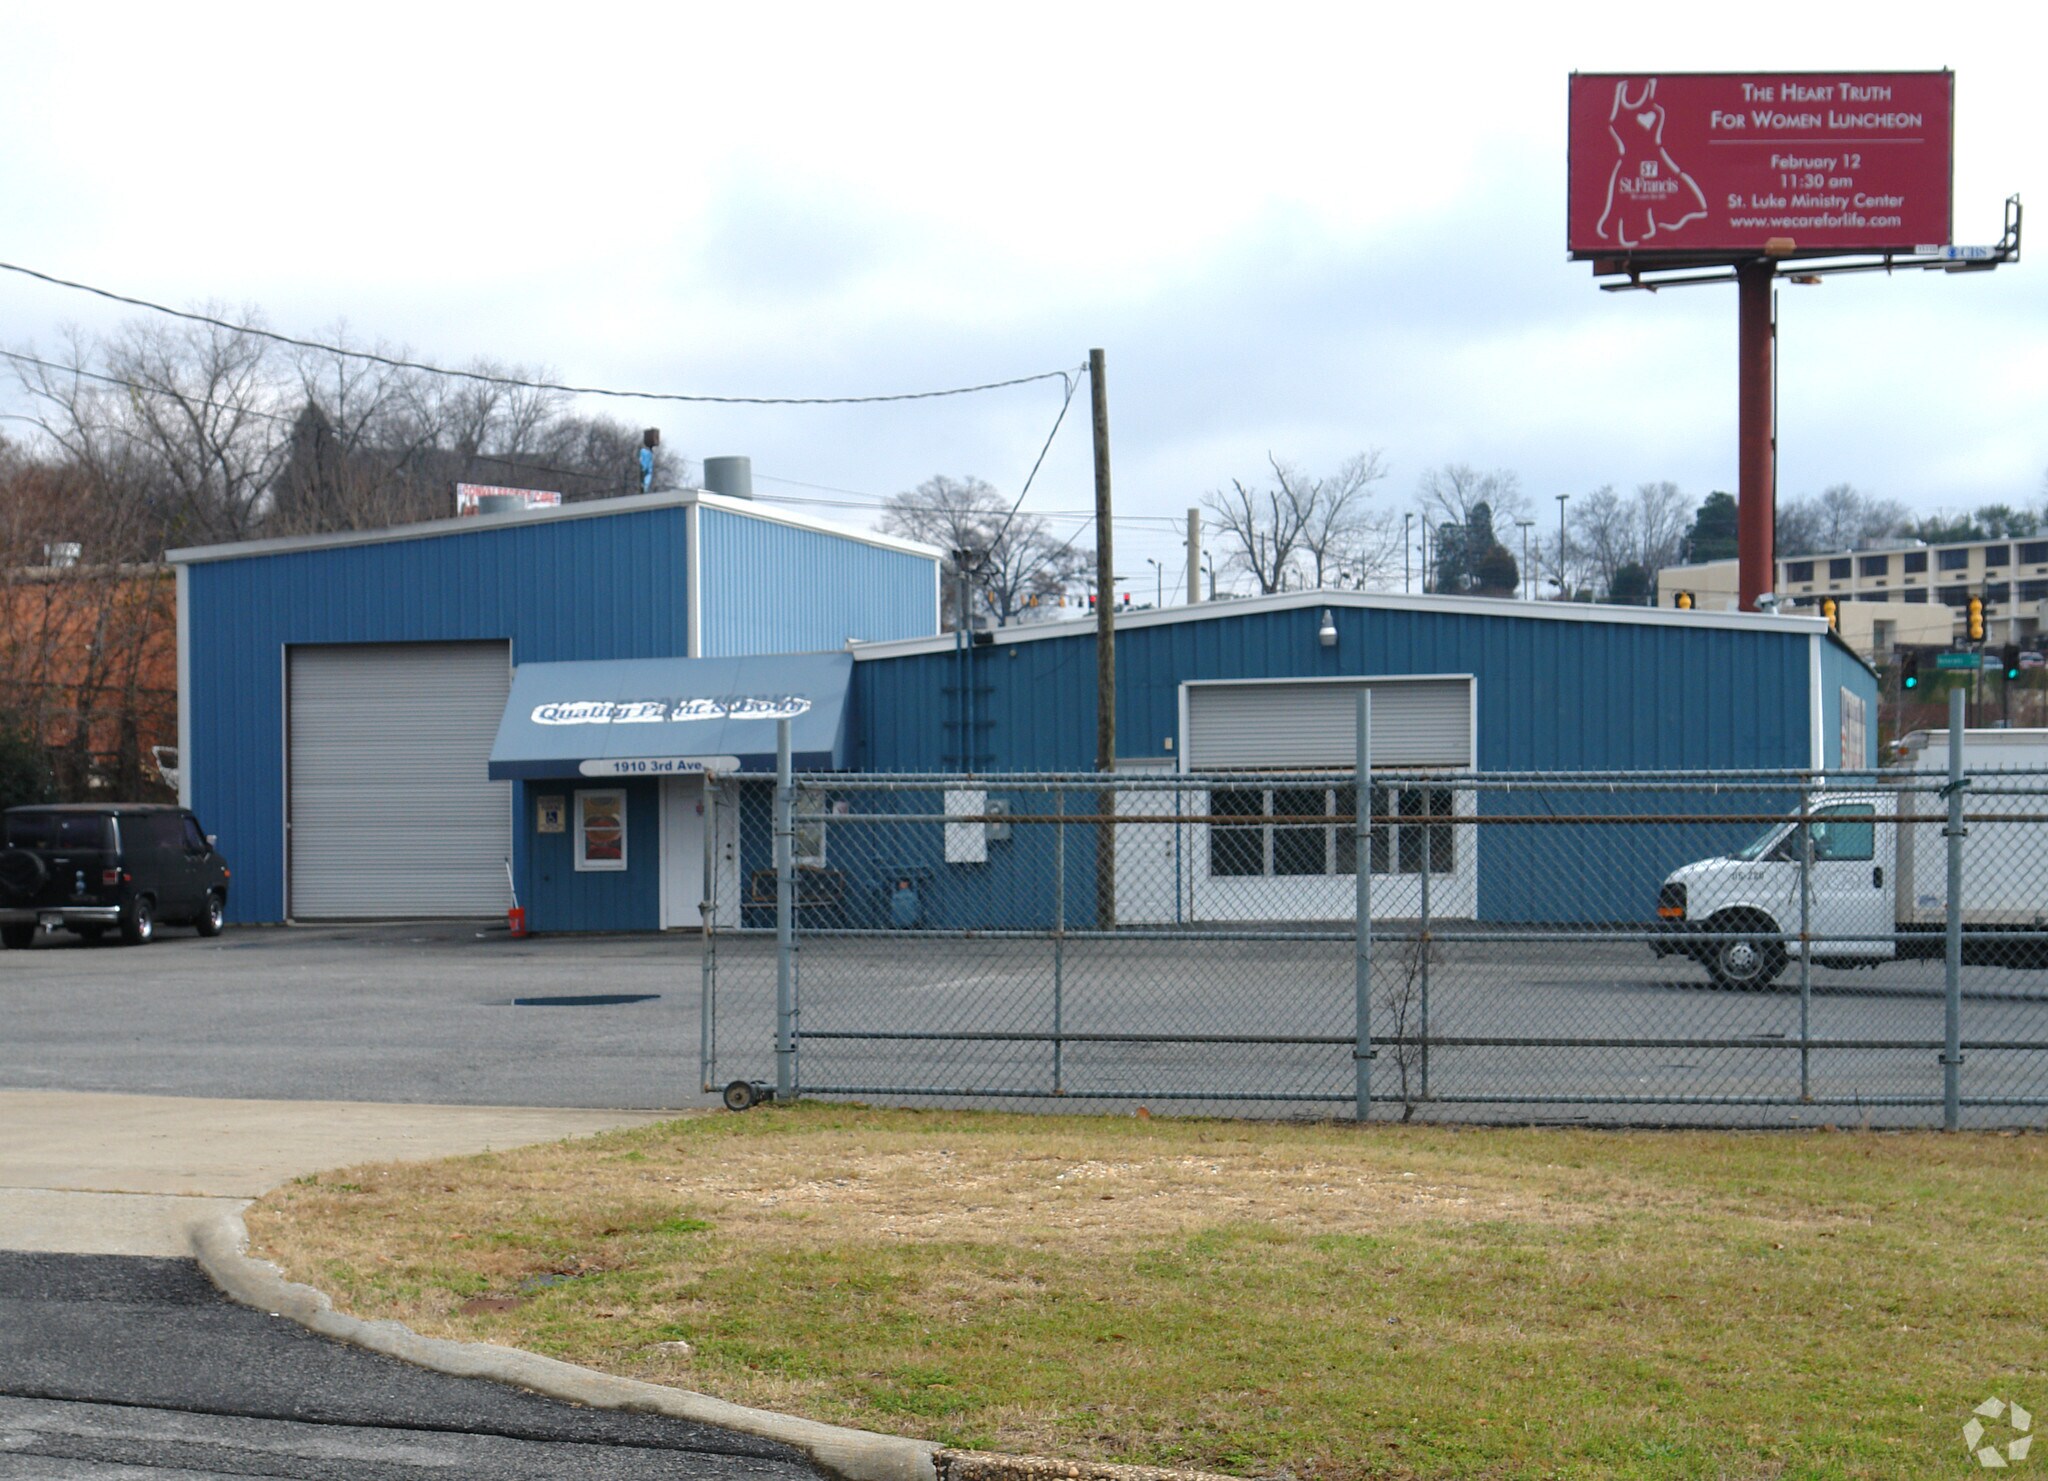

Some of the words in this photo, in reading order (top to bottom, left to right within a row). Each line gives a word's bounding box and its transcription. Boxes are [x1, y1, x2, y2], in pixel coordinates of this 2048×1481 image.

[1771, 154, 1837, 171] February
[1843, 154, 1861, 168] 12
[1780, 173, 1825, 188] 11:30
[1828, 177, 1853, 188] am
[1727, 194, 1747, 208] St.
[1752, 193, 1787, 208] Luke
[1791, 192, 1850, 210] Ministry
[1853, 193, 1904, 208] Center
[1730, 212, 1902, 228] www.wecareforlife.com
[1961, 247, 1987, 257] CBS
[539, 705, 630, 721] Quality
[613, 761, 646, 773] 1910
[650, 760, 673, 772] 3rd
